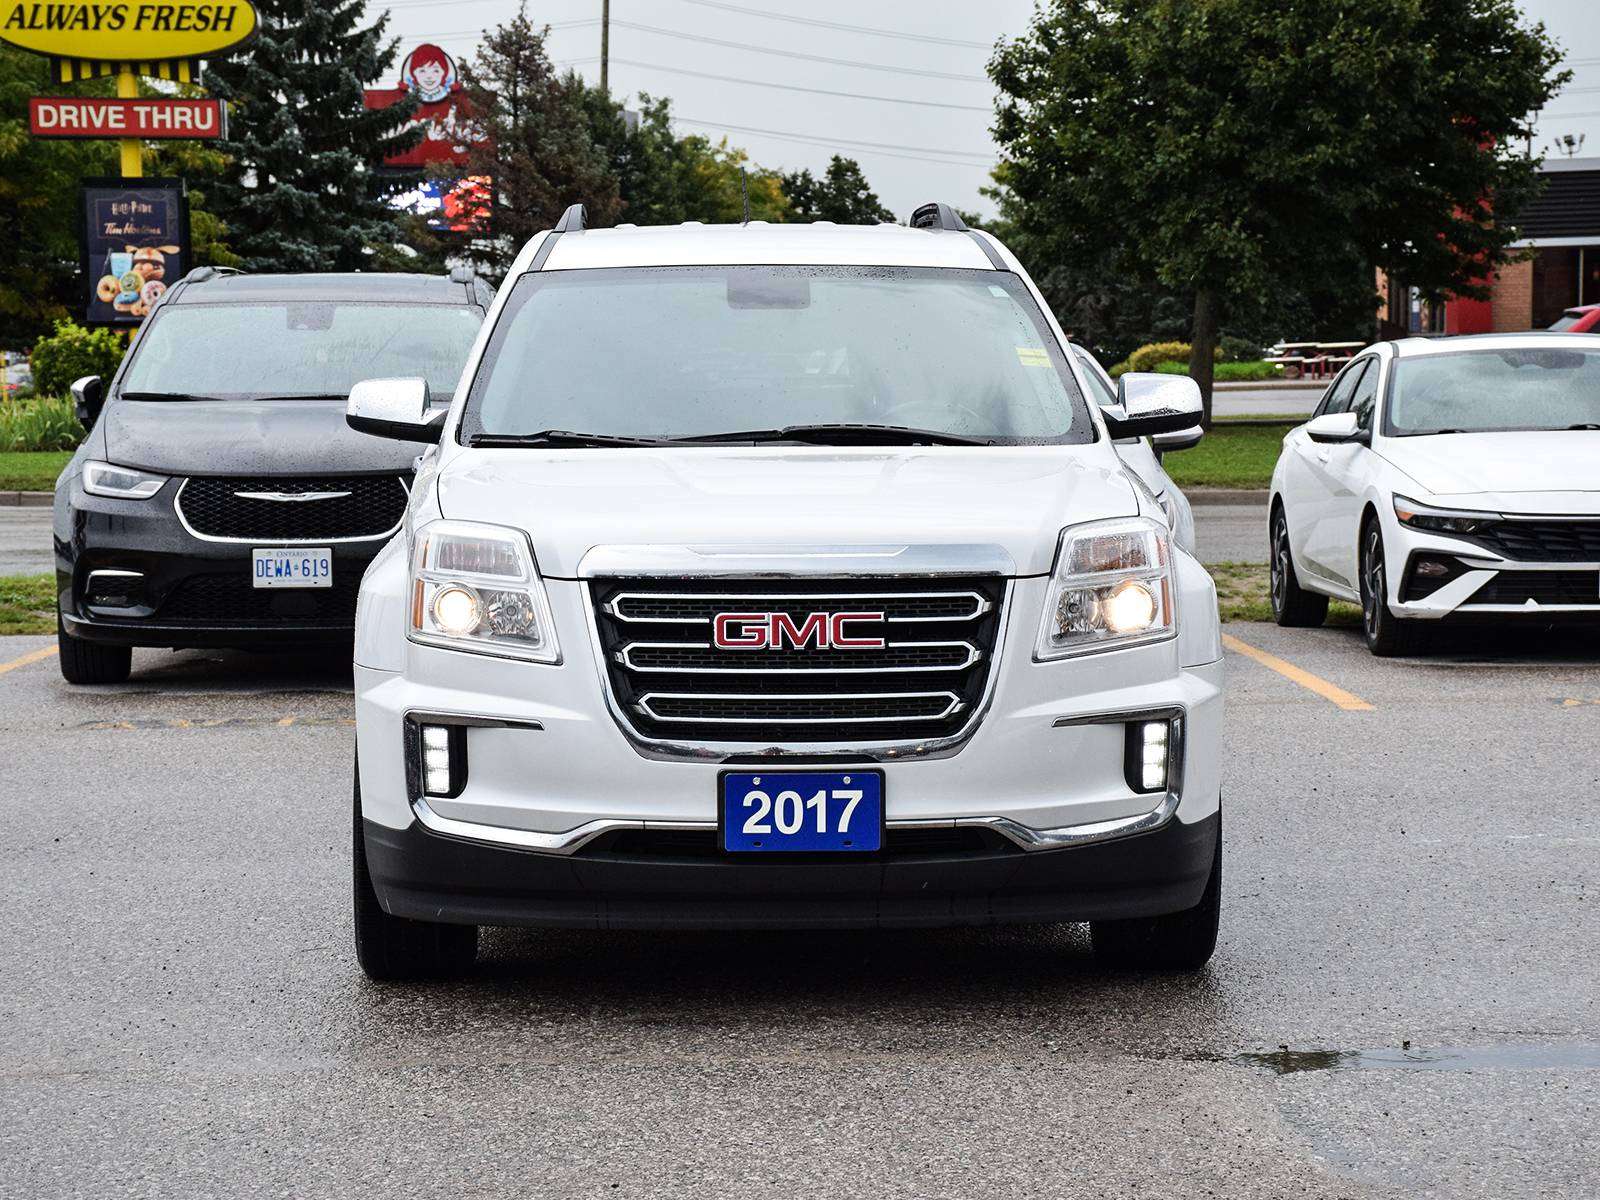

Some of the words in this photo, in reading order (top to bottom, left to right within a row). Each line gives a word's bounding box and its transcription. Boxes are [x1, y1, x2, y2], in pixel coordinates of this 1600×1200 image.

[4, 3, 128, 30] ALWAYS
[133, 5, 238, 31] FRESH
[38, 105, 126, 129] DRIVE
[133, 106, 213, 130] THRU
[714, 612, 886, 649] GMC
[742, 790, 863, 834] 2017
